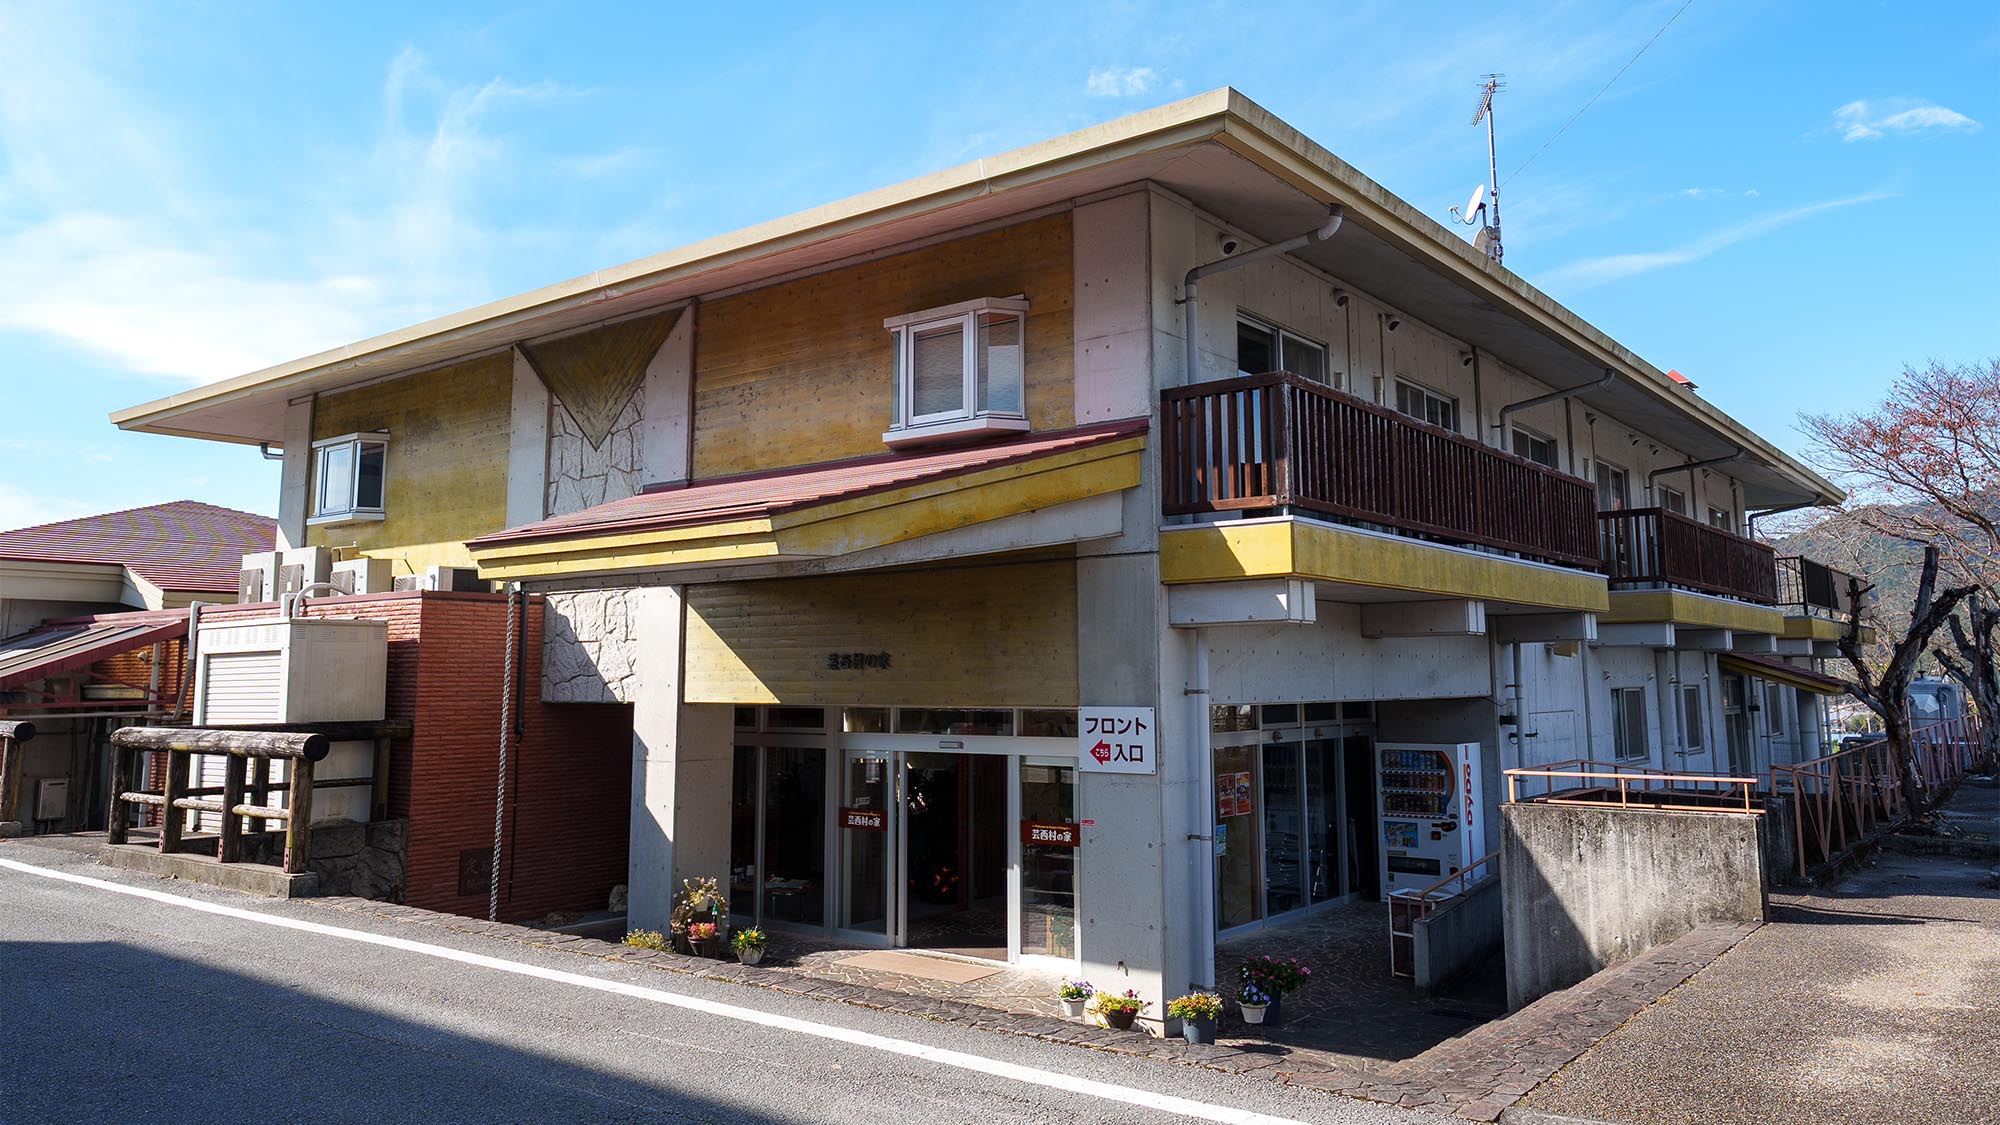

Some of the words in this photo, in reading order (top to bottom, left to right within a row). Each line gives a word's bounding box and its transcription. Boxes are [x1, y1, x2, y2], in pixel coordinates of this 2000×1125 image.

[1085, 717, 1147, 735] フロント
[1095, 748, 1109, 757] こちら
[1113, 744, 1143, 762] 入口
[847, 815, 880, 827] 芸西村の家
[1032, 829, 1072, 842] 芸西村の家
